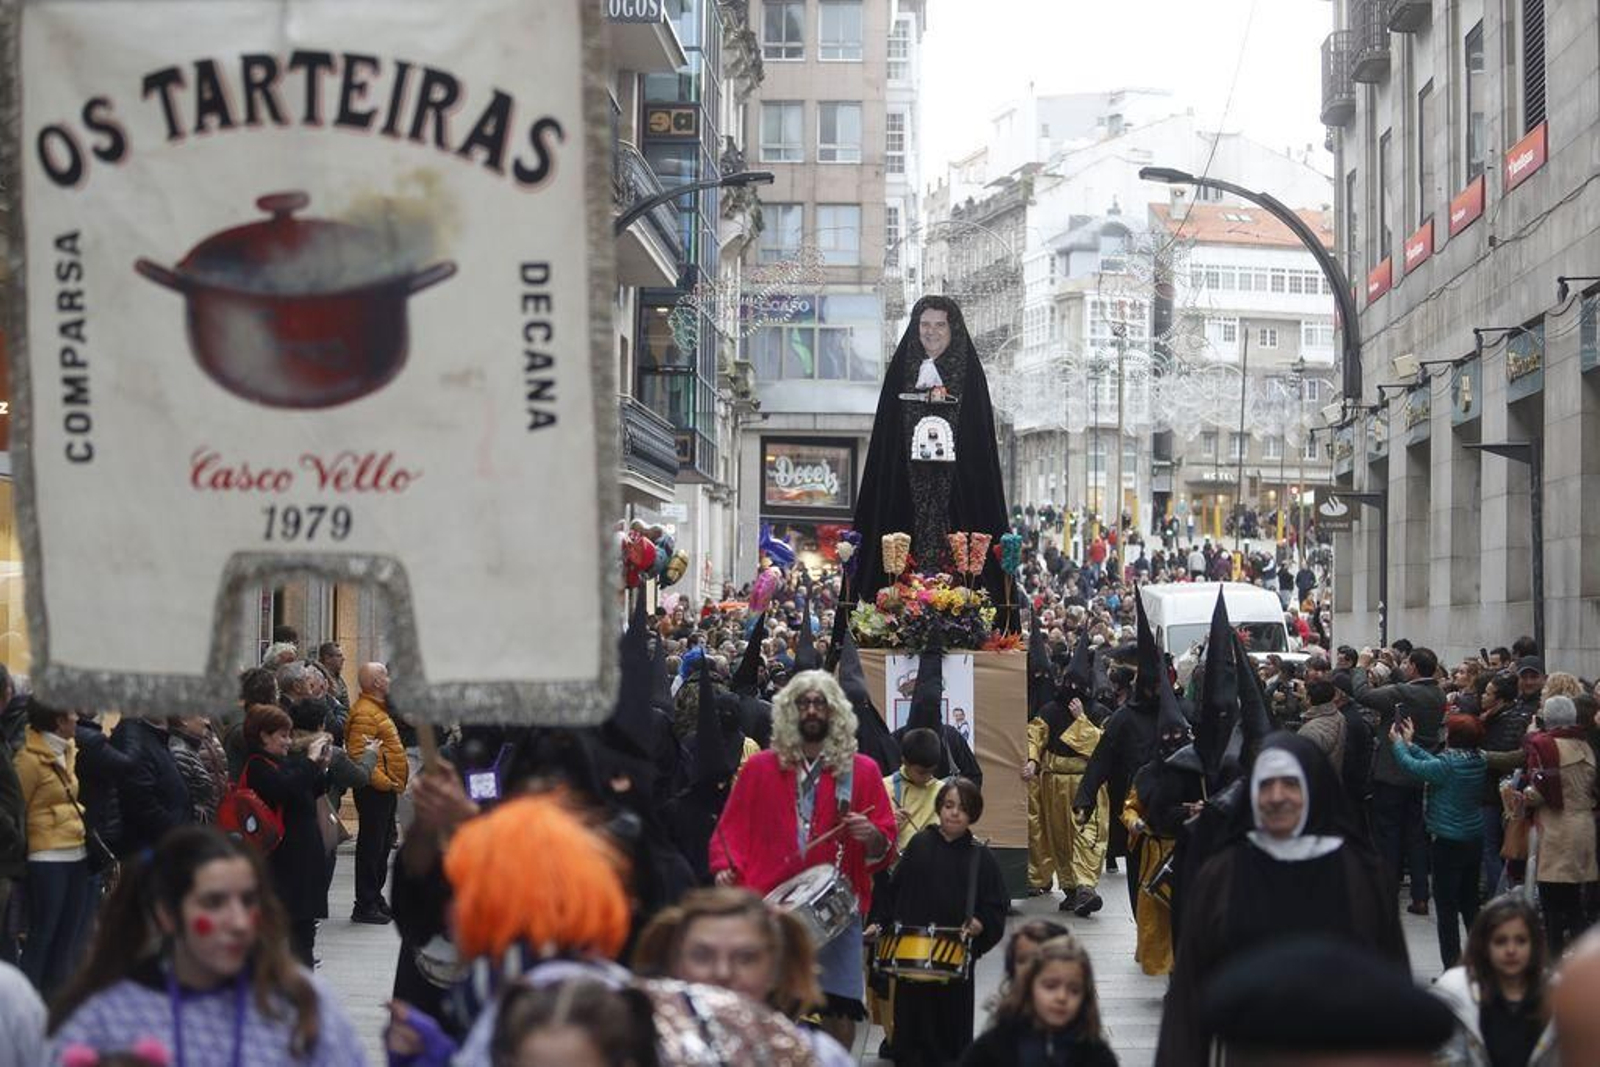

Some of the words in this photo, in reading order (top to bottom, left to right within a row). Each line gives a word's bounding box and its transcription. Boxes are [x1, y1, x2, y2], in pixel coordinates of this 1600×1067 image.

[37, 95, 130, 189] OS
[141, 49, 566, 191] TARTEIRAS
[54, 230, 94, 464] COMPARSA
[518, 261, 557, 432] DECANA
[189, 448, 294, 493] Casco
[300, 451, 424, 493] Vello
[261, 502, 354, 542] 1979
